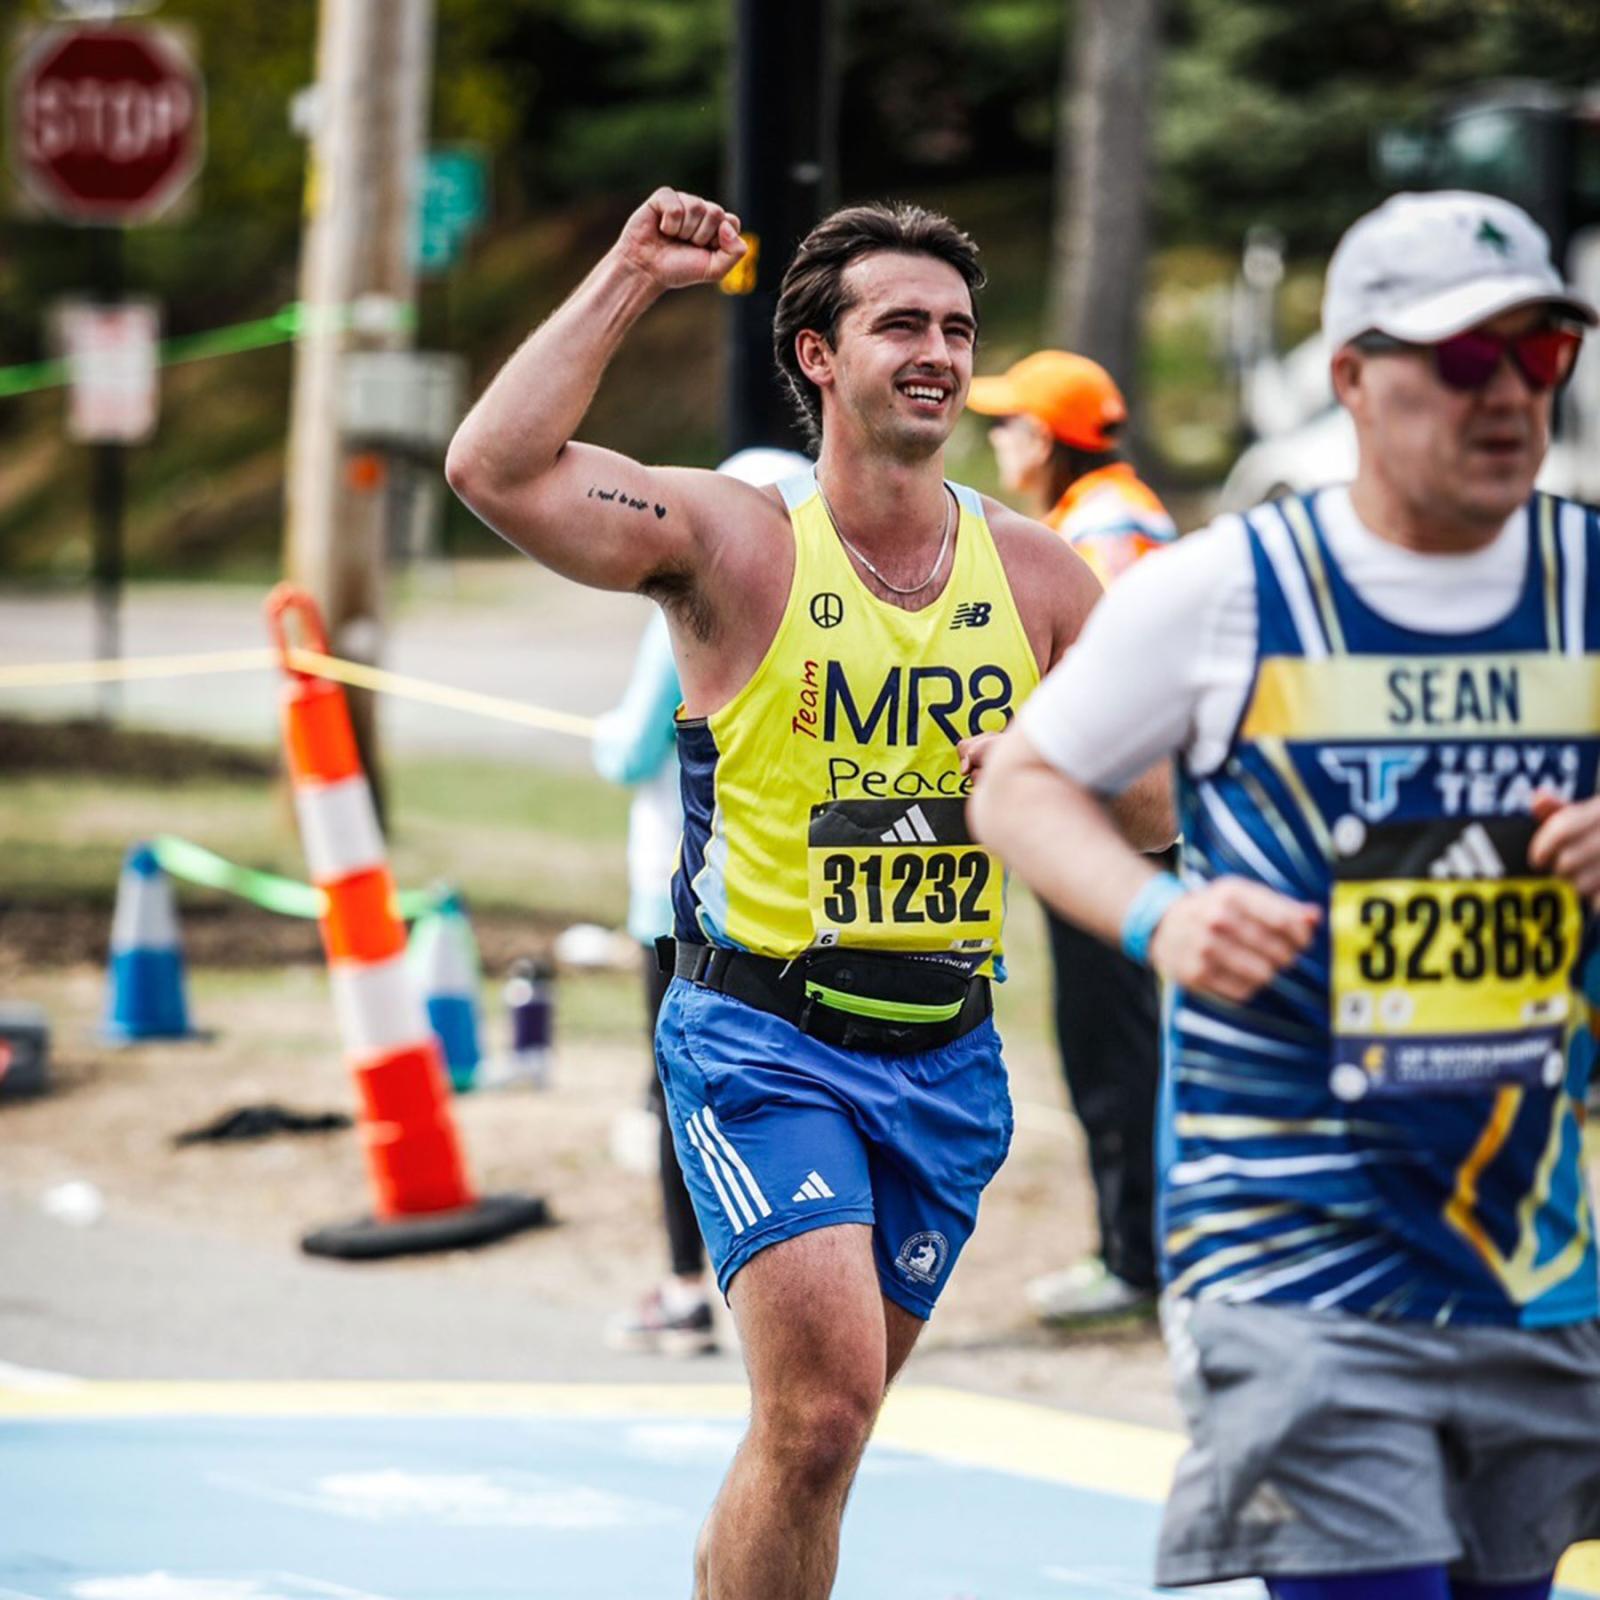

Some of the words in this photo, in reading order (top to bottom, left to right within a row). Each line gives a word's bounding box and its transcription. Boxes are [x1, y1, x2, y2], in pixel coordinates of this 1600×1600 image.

[25, 80, 192, 160] STOP
[792, 660, 819, 739] Team
[823, 660, 1014, 747] MR8
[1388, 667, 1521, 724] SEAN
[824, 851, 991, 923] 31232
[820, 934, 833, 945] 6
[1360, 891, 1563, 983] 32363
